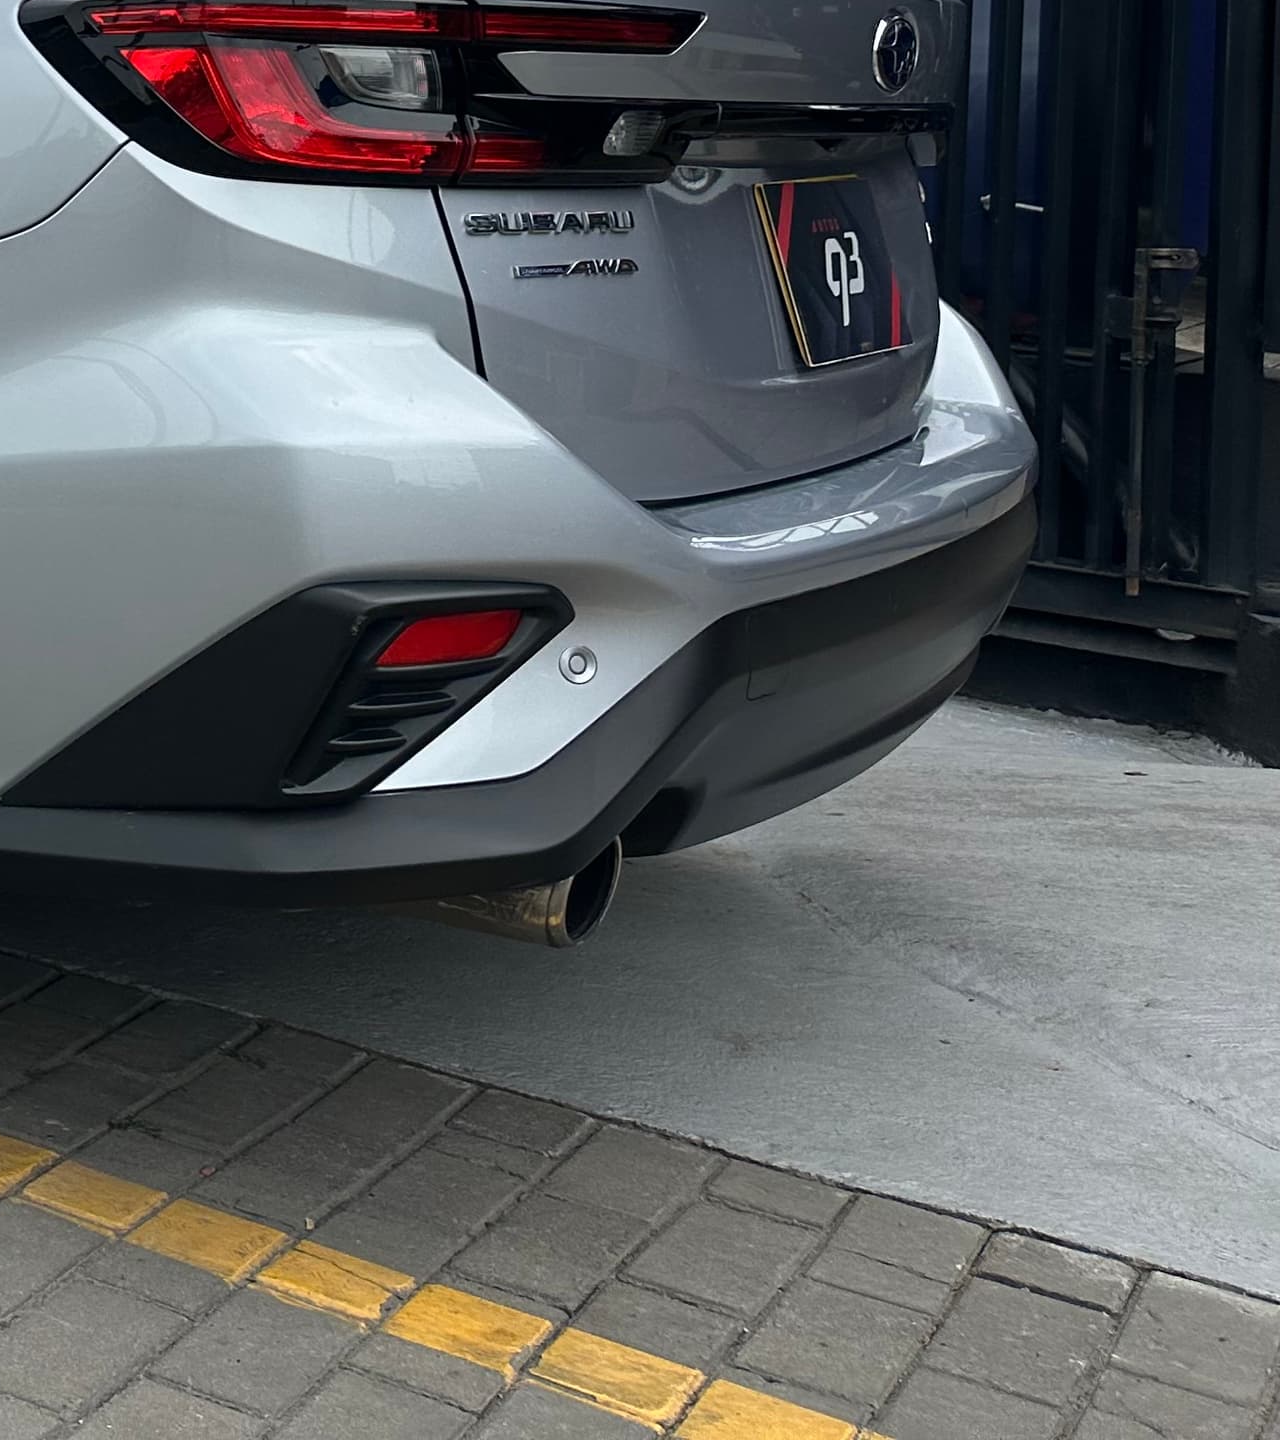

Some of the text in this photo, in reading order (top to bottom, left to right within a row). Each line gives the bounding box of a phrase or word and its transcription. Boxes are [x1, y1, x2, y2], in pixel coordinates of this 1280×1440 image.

[464, 211, 634, 235] SUBARU
[566, 258, 639, 276] AWD
[825, 232, 864, 327] 93
